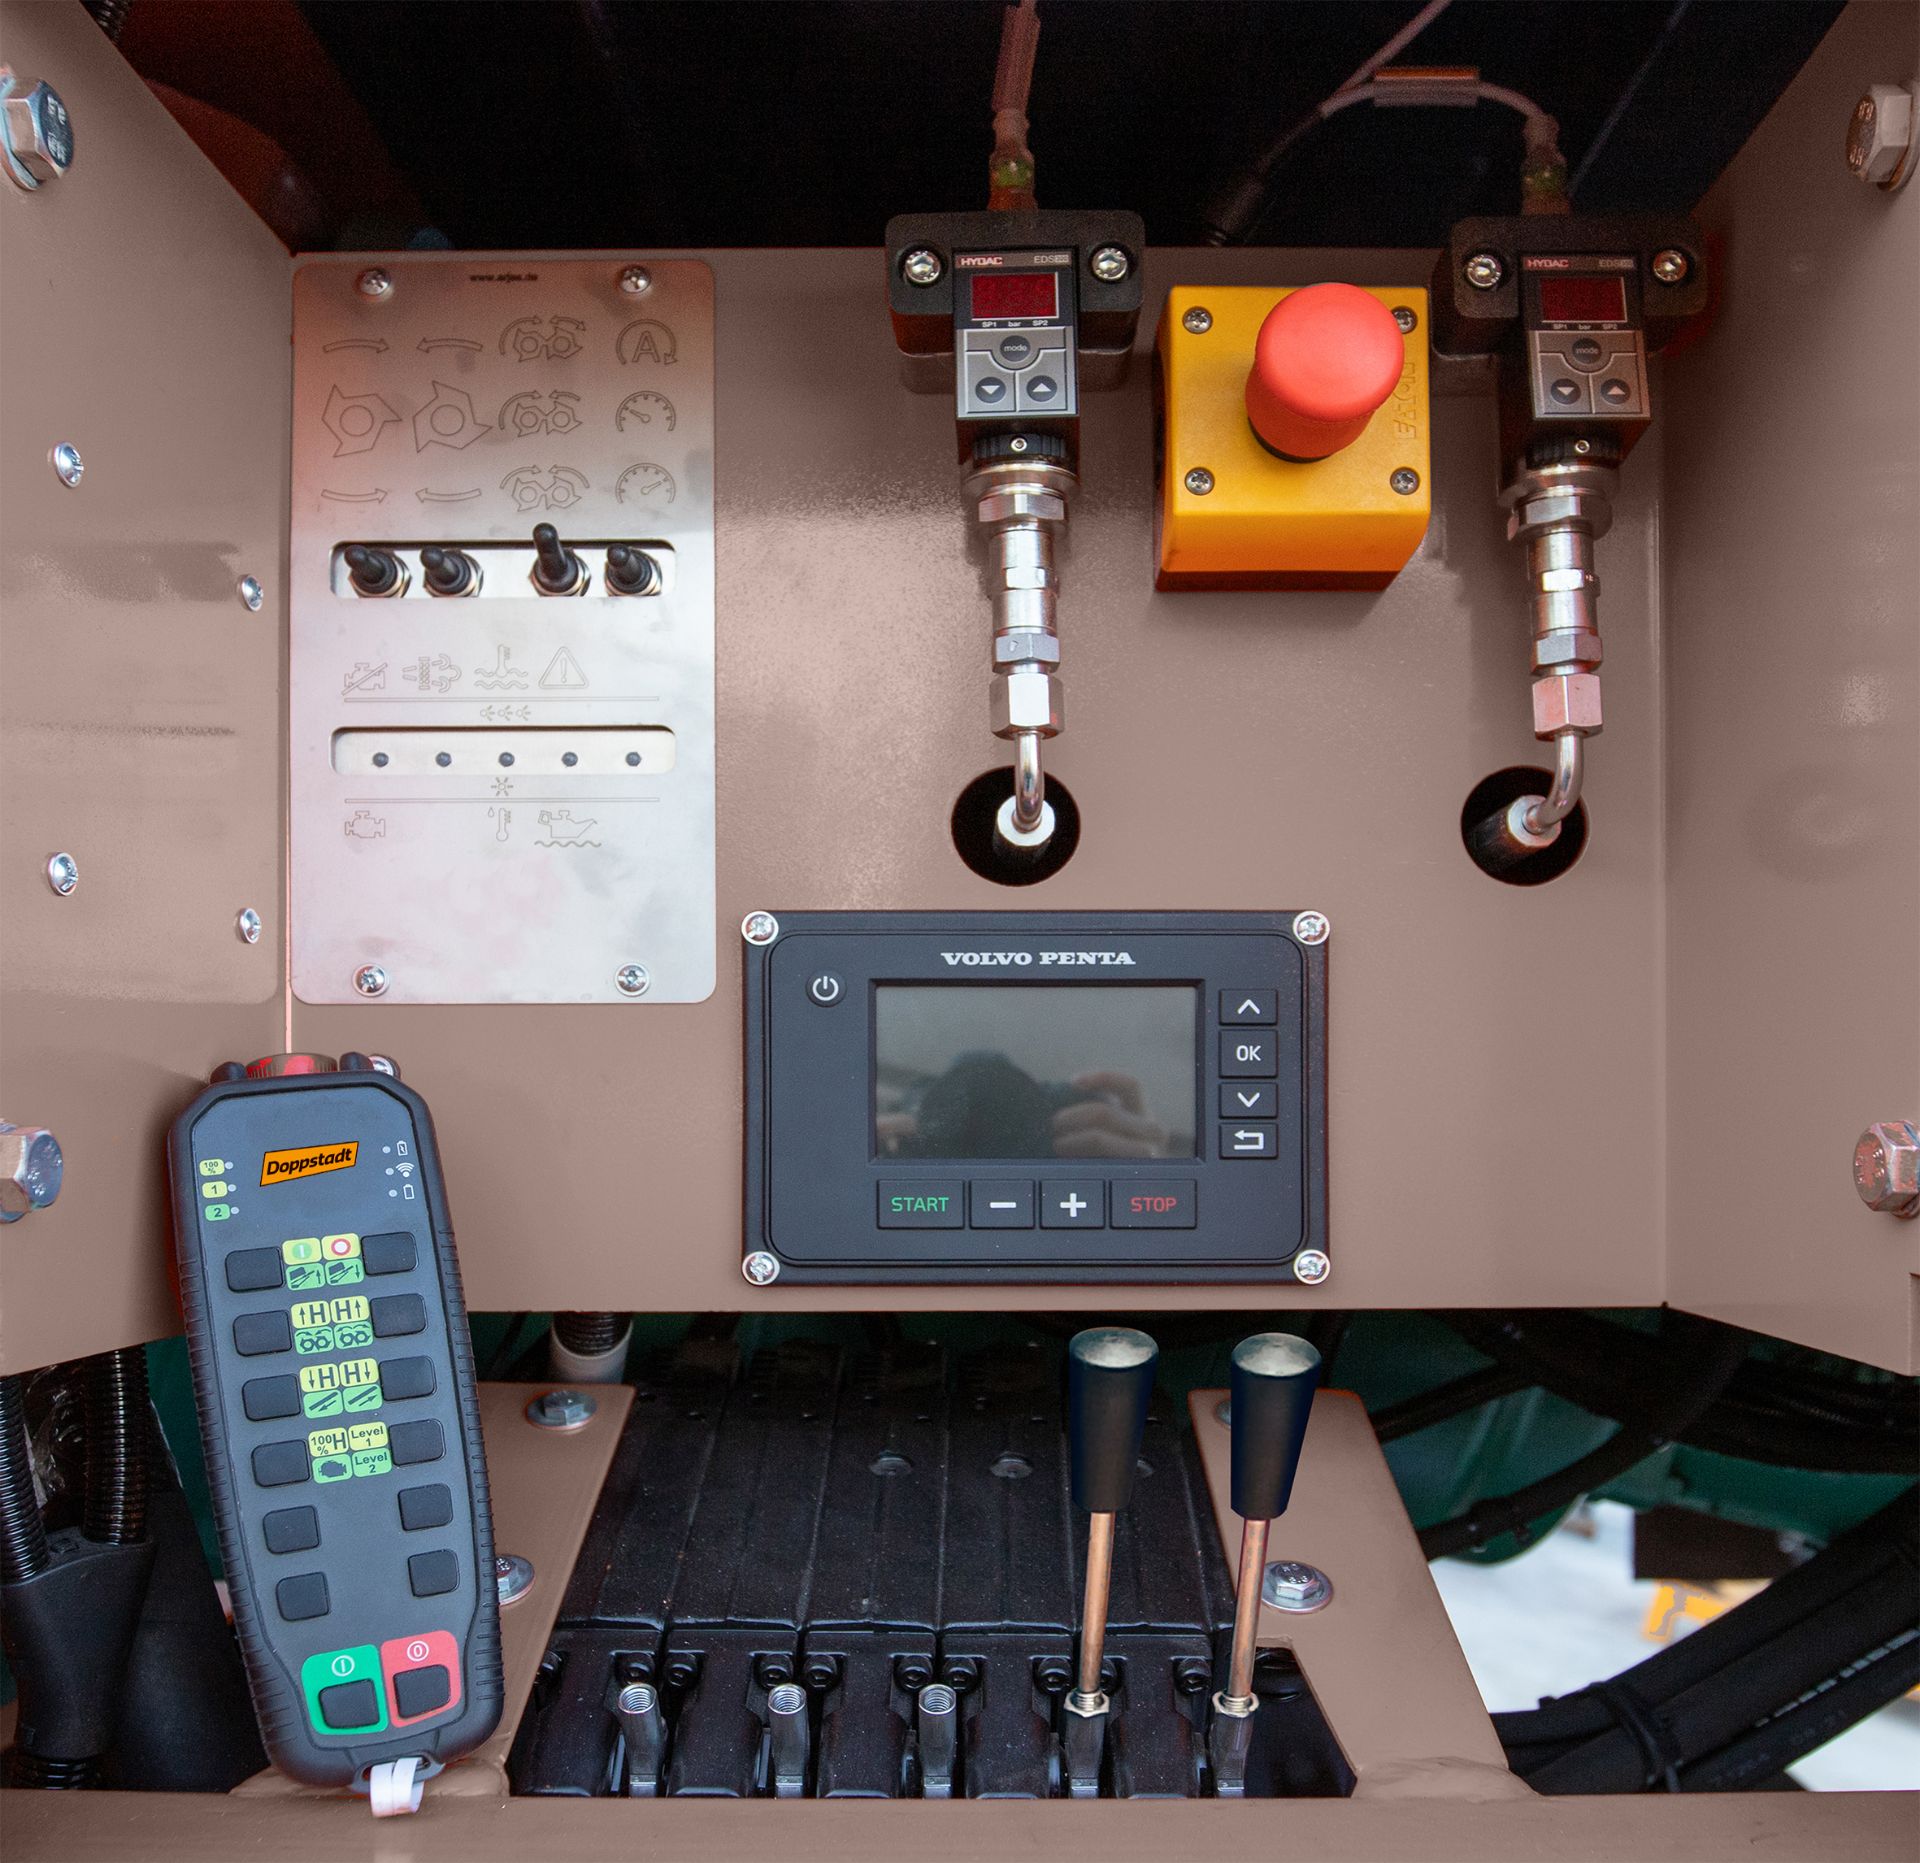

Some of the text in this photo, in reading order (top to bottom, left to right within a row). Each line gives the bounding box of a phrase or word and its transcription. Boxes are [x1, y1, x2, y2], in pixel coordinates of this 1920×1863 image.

[961, 256, 1003, 266] HYDAC
[1527, 259, 1569, 268] HYDAC
[1003, 342, 1028, 352] mode
[1575, 346, 1599, 355] mode
[940, 952, 1136, 966] VOLVO PENTA
[1236, 1045, 1262, 1062] OK
[204, 1160, 219, 1169] 100
[266, 1148, 352, 1175] Doppstadt
[211, 1185, 218, 1195] 1
[891, 1197, 949, 1213] START
[1131, 1197, 1177, 1213] STOP
[213, 1207, 222, 1218] 2
[351, 1426, 384, 1439] Level
[311, 1435, 332, 1446] 100
[366, 1438, 372, 1447] 1
[355, 1452, 388, 1465] Level
[369, 1464, 376, 1474] 2
